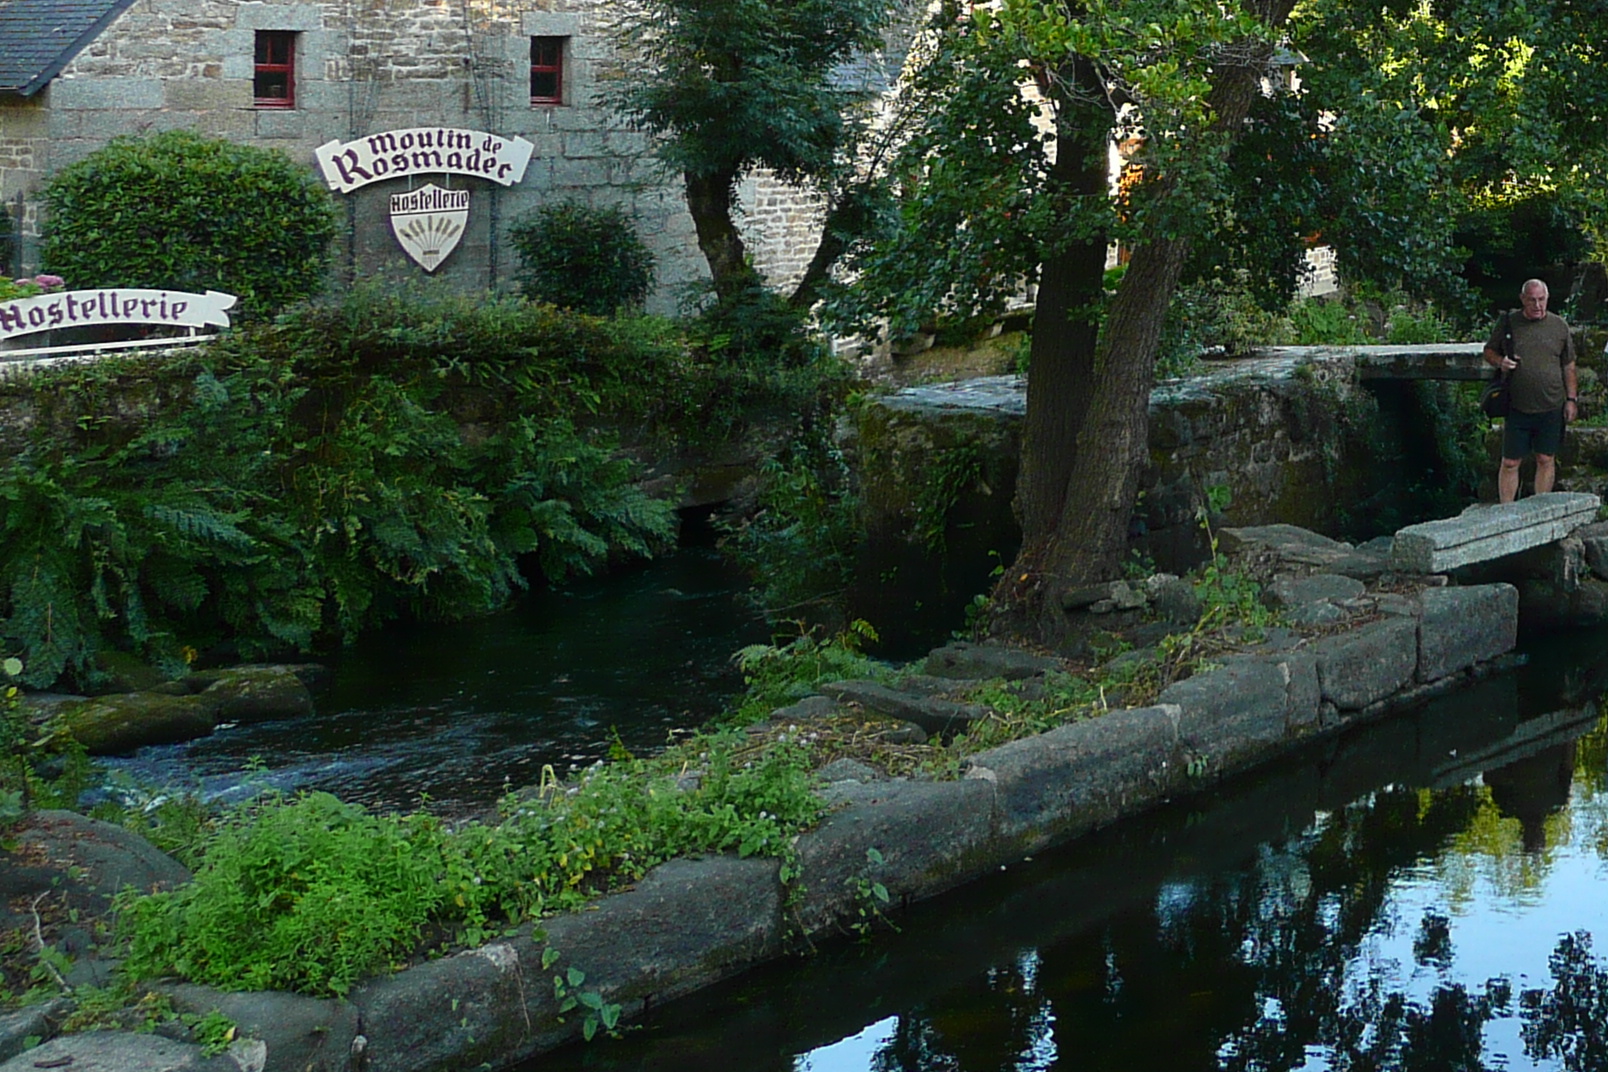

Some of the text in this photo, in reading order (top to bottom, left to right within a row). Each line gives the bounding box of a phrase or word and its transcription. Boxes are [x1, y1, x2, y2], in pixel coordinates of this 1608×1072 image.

[482, 136, 502, 154] de
[332, 148, 513, 185] Rosmadec
[391, 187, 469, 212] Hostellerie
[0, 292, 187, 332] Hostellerie
